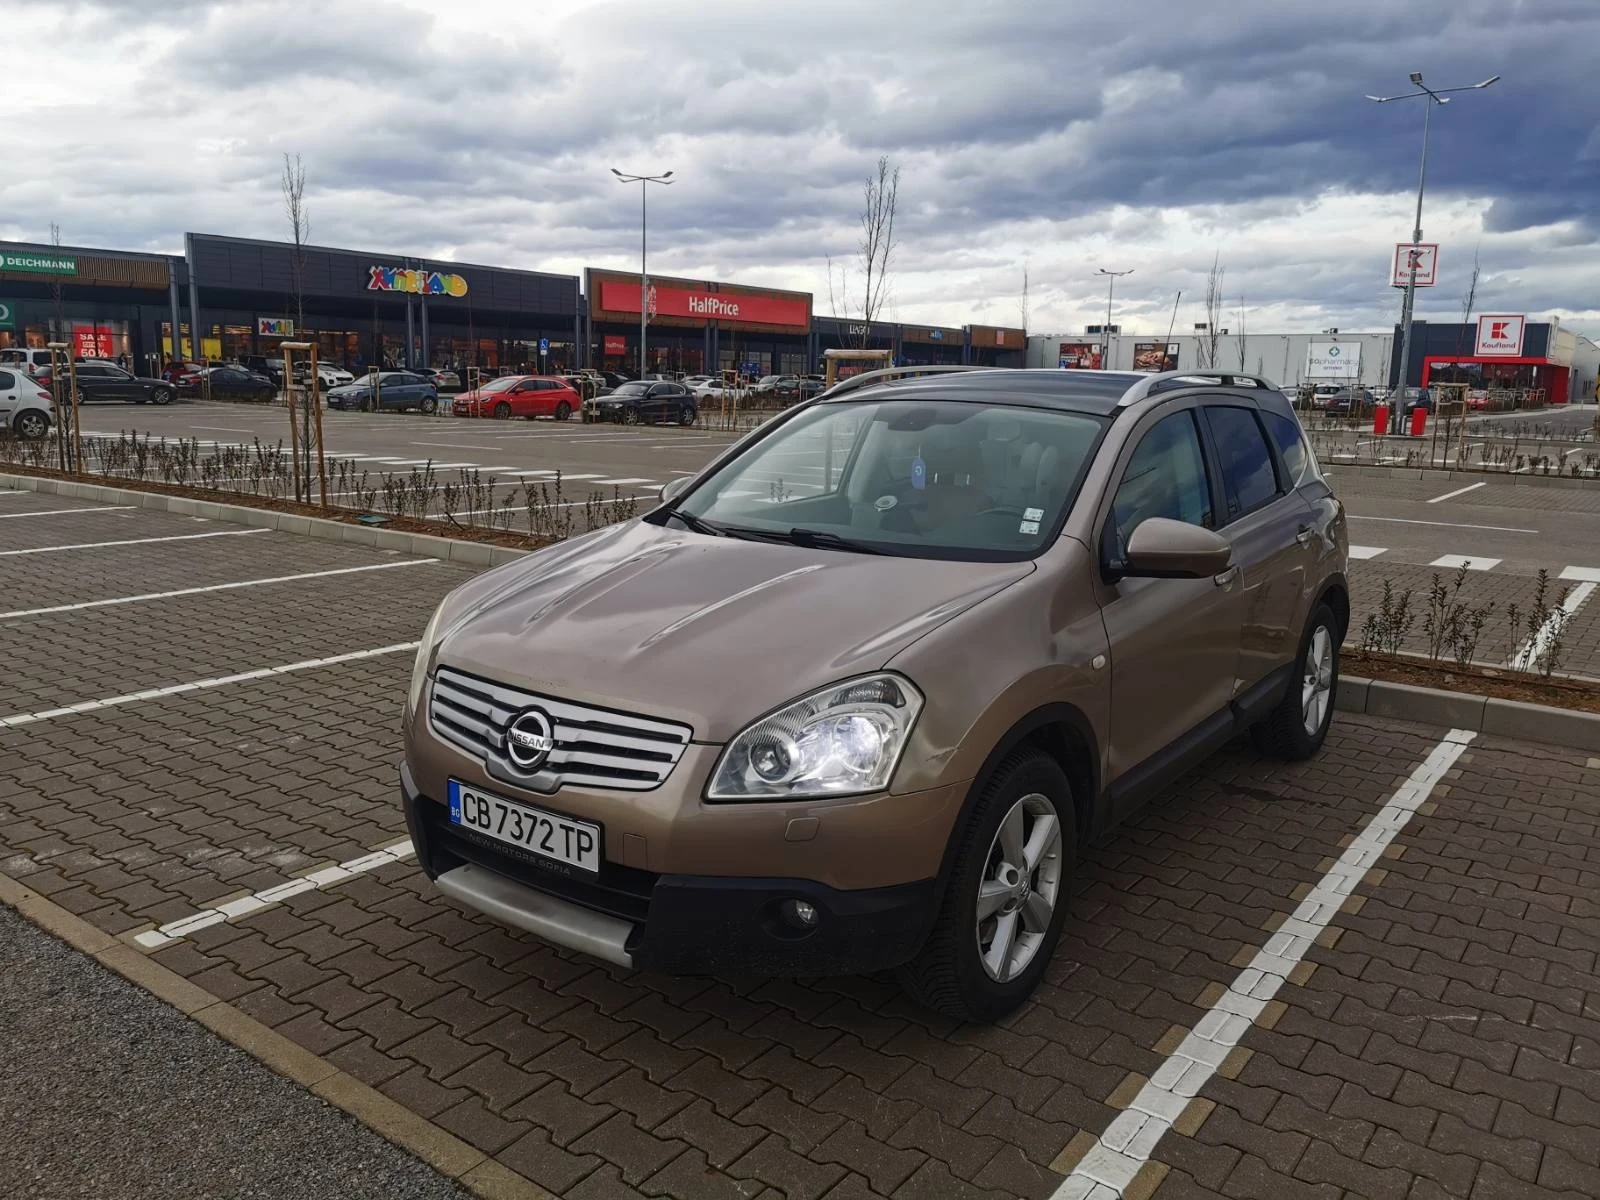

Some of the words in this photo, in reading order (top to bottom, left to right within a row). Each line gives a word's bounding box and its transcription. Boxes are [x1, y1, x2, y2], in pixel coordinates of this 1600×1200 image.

[6, 257, 75, 269] DEICHMANN
[688, 296, 739, 316] HalfPrice
[79, 333, 107, 341] SAE
[508, 729, 546, 748] NISSAN
[451, 806, 460, 818] BG
[463, 792, 491, 830] CB
[495, 803, 555, 853] 7372
[559, 823, 593, 862] TP
